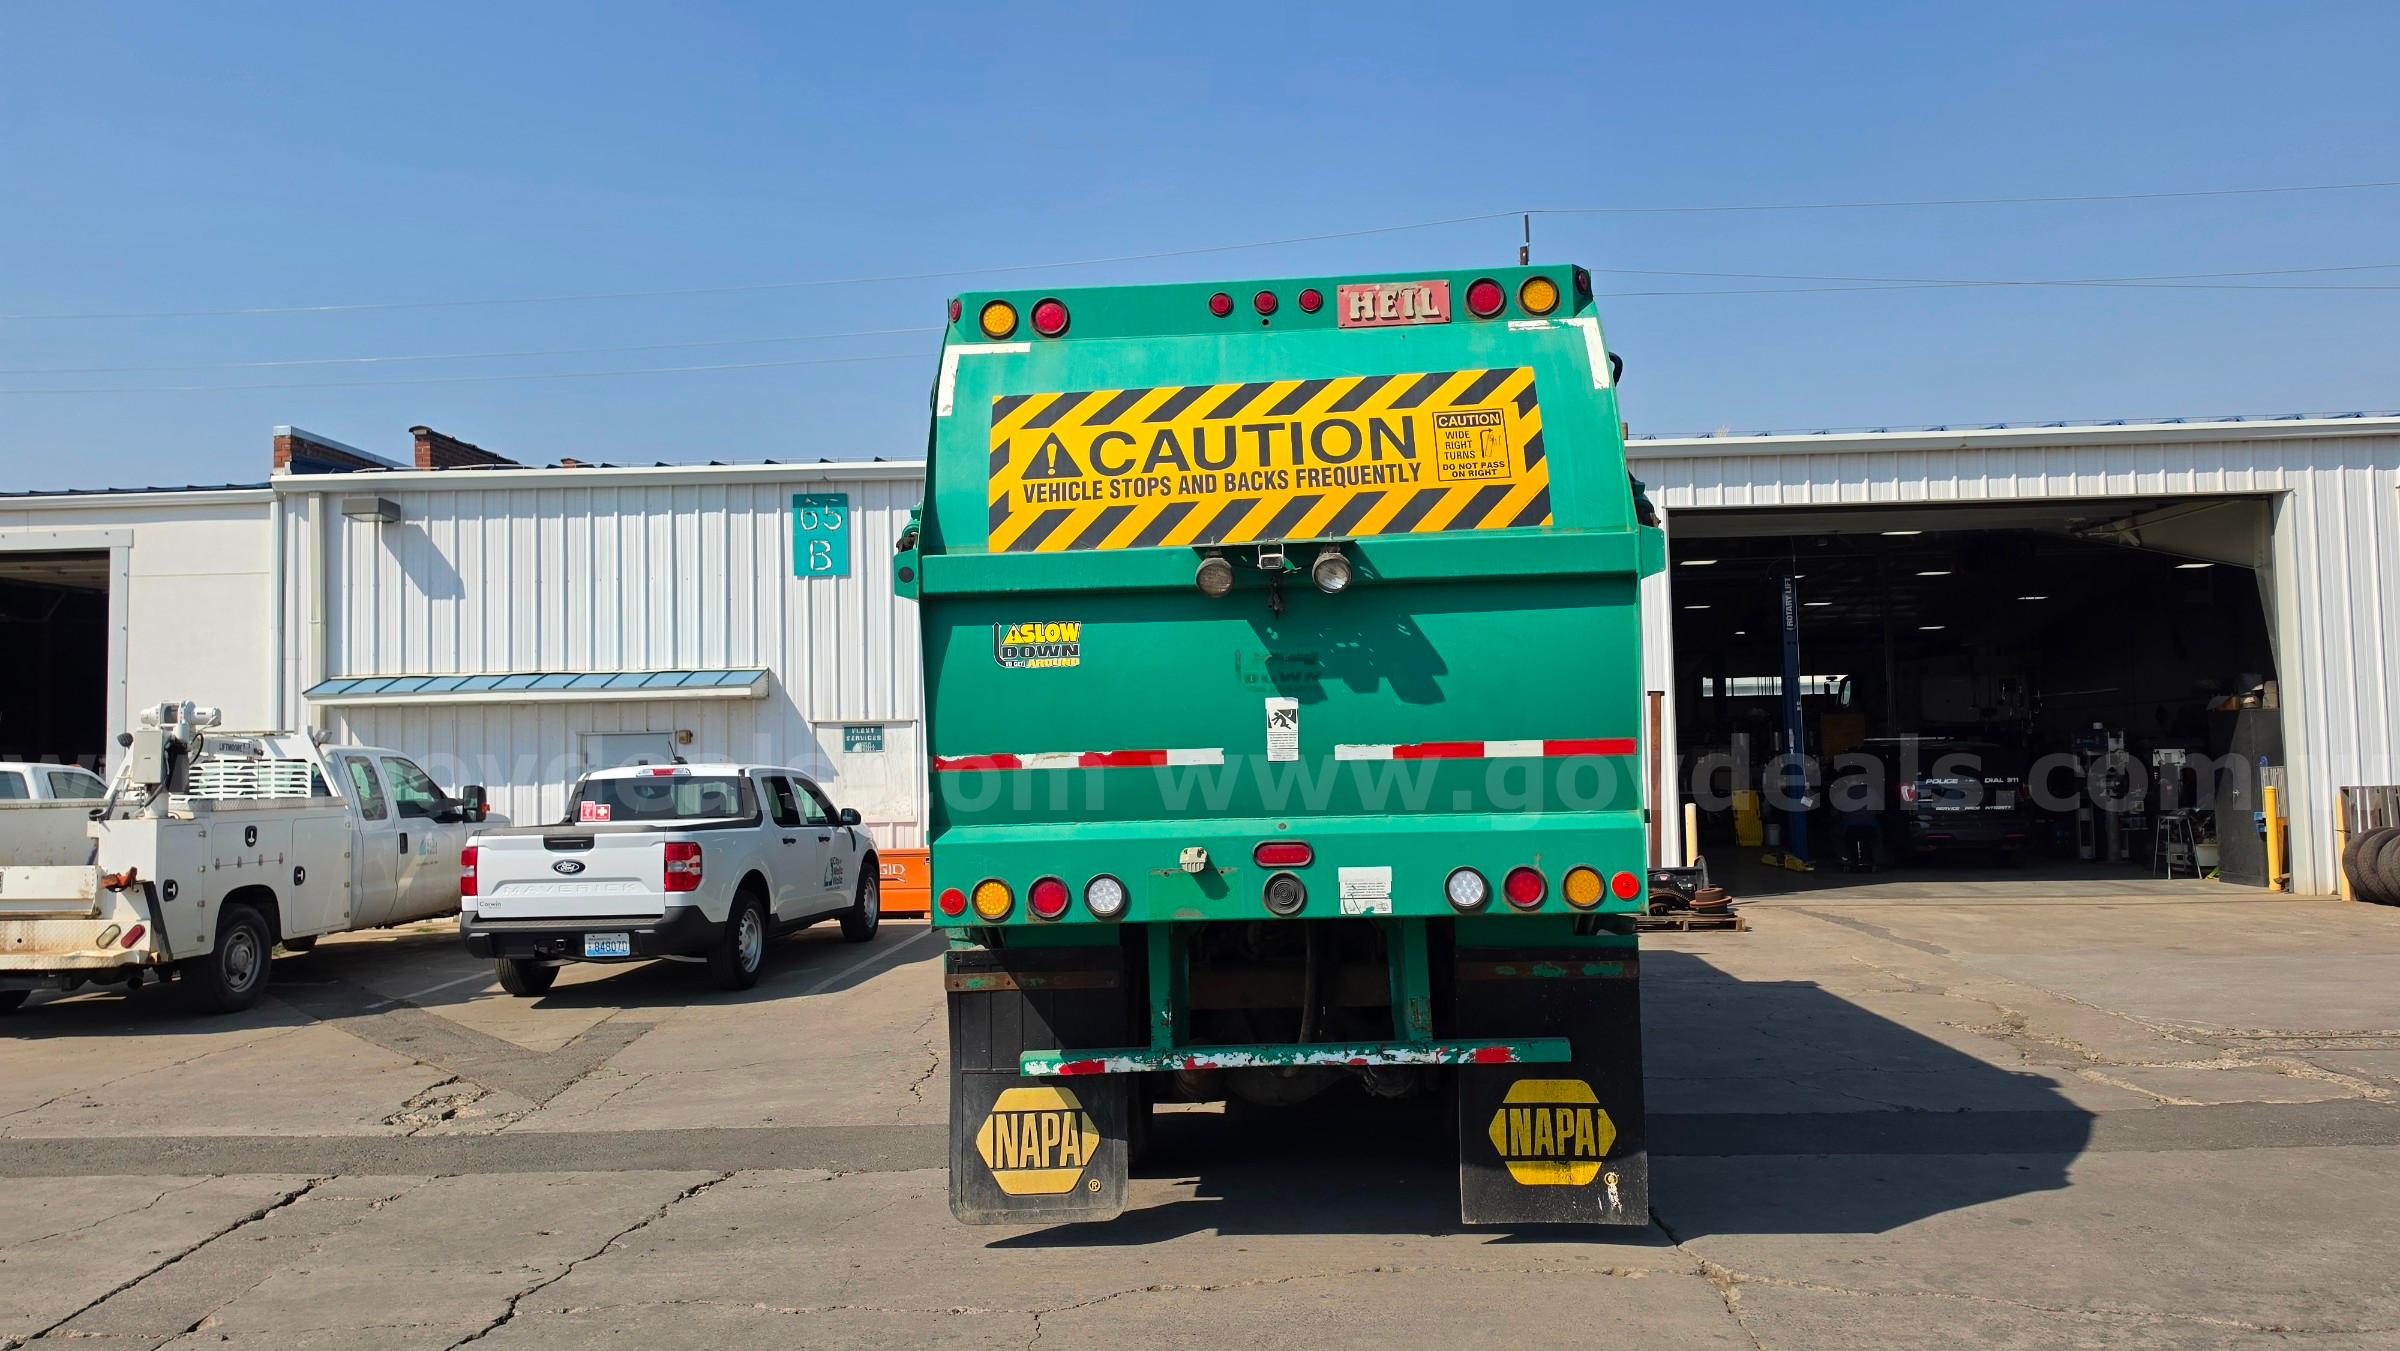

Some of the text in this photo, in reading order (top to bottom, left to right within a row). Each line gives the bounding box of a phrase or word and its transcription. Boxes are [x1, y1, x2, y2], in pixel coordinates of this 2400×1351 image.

[1349, 288, 1441, 320] HEIL
[1438, 413, 1500, 427] CAUTION
[1445, 431, 1471, 439] WIDE
[1089, 415, 1417, 477] CAUTION
[1445, 440, 1473, 450] RIGHT
[1444, 450, 1476, 460] TURNS
[1443, 461, 1505, 471] DO NOT PASS
[1452, 469, 1498, 478] ON RIGHT
[1022, 462, 1422, 504] VEHICLE STOPS AND BACKS FREQUENTLY
[809, 539, 833, 571] B
[1020, 622, 1080, 644] SLOW
[1002, 645, 1080, 658] DOWN
[1013, 660, 1024, 668] GET
[1027, 658, 1080, 668] AROUND
[880, 863, 905, 875] GID
[501, 882, 640, 897] MAVERICK
[1509, 1108, 1597, 1156] NAPA
[995, 1111, 1082, 1169] NAPA
